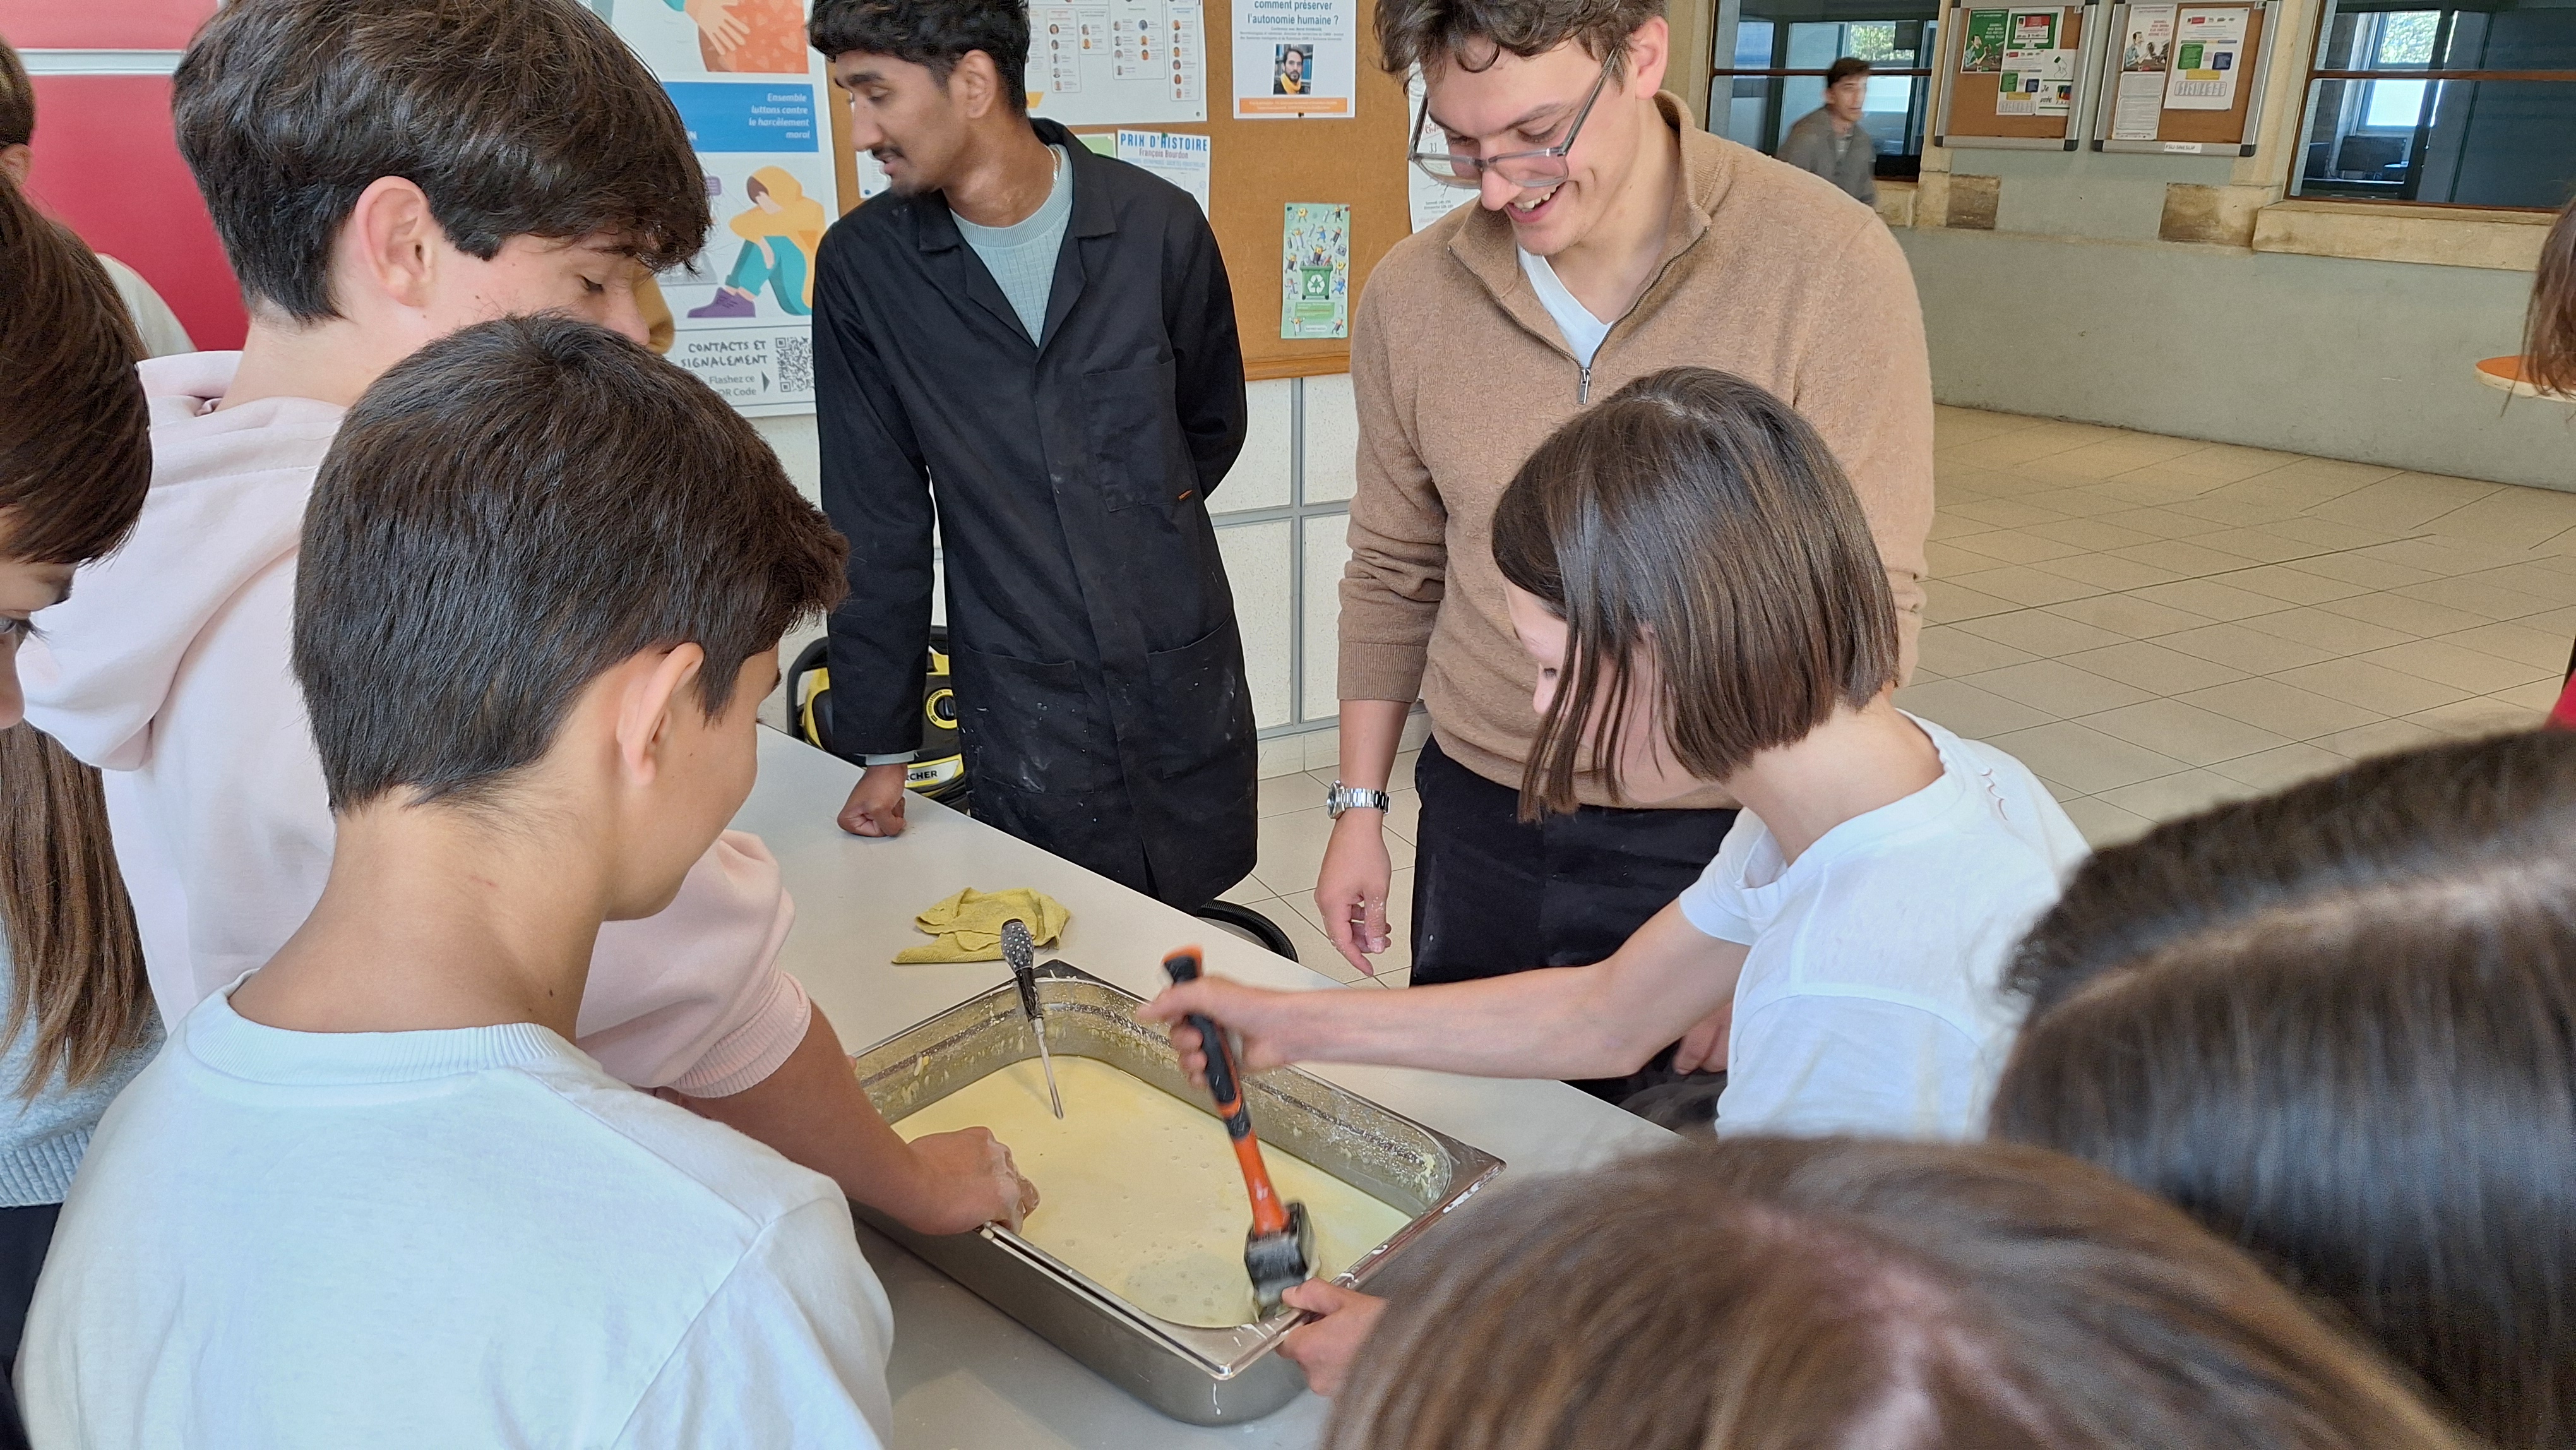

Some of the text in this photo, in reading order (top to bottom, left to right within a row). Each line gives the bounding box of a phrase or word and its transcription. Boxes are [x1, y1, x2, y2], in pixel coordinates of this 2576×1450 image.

[1254, 0, 1332, 11] comment préserver
[1248, 13, 1339, 25] l'autonomie humaine ?
[767, 93, 807, 102] Ensemble
[751, 105, 780, 114] luttons
[748, 117, 810, 126] le harcèlement
[1120, 133, 1207, 152] PRIX D'HISTOIRE
[1139, 148, 1189, 159] François Bourdon
[688, 340, 766, 353] CONTACTS ET
[681, 355, 767, 368] SIGNALEMENT
[709, 375, 743, 384] Flashez
[733, 387, 756, 395] Code
